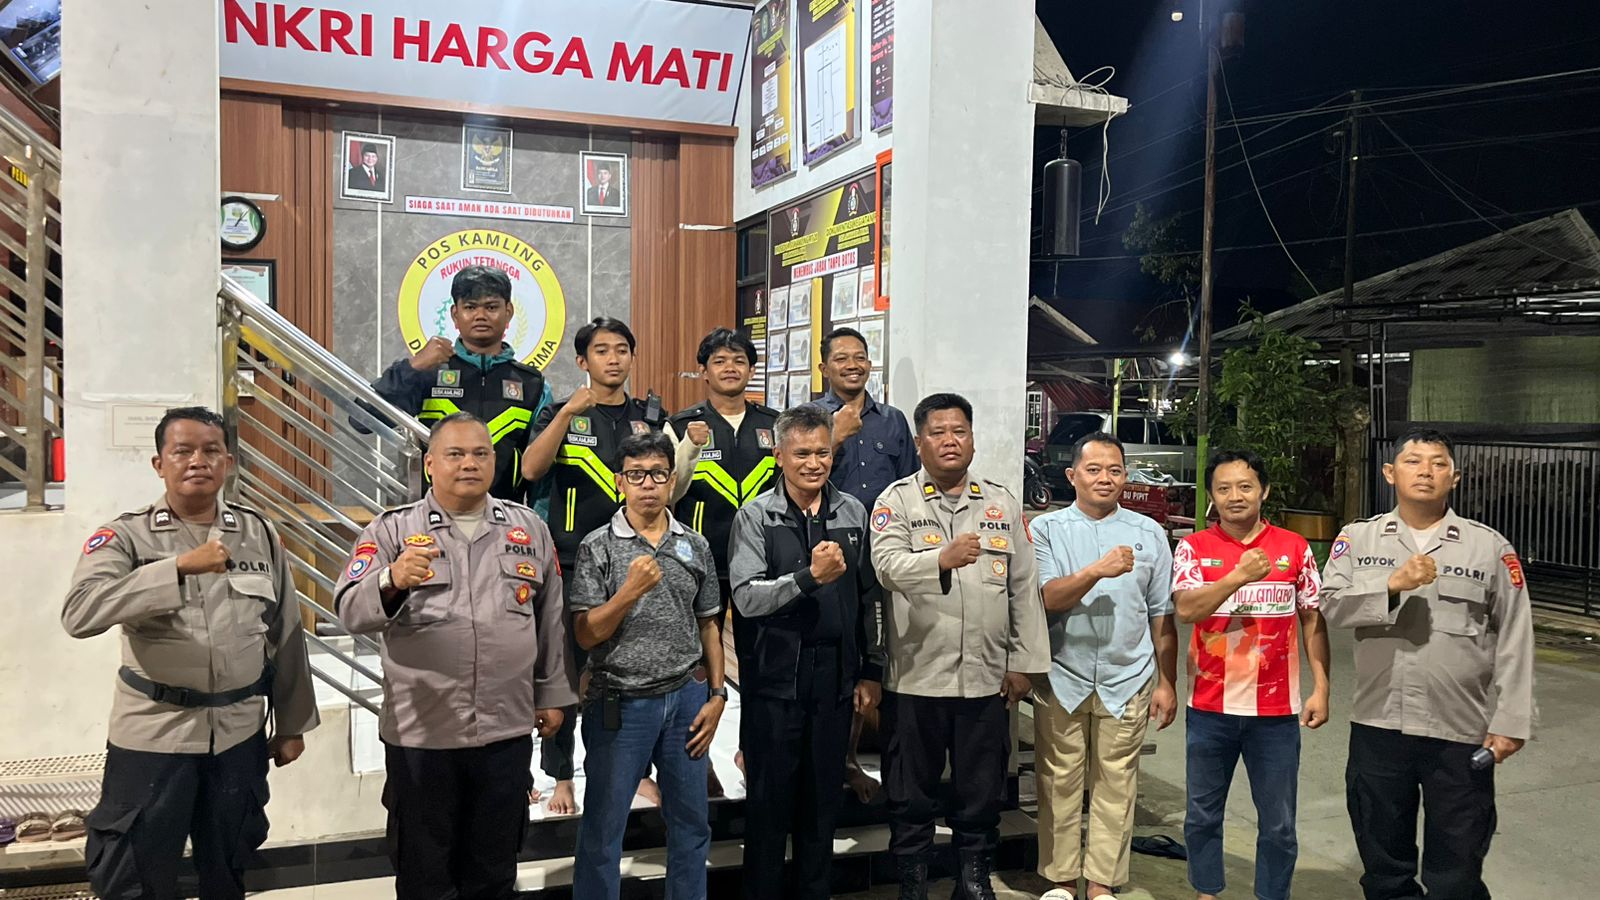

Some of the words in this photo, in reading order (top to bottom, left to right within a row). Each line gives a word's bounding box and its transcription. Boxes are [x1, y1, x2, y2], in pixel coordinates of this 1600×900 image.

[223, 0, 373, 57] NKRI
[393, 17, 594, 79] HARGA
[606, 41, 734, 92] MATI
[408, 199, 433, 209] SIAGA
[435, 201, 455, 210] SAAT
[458, 202, 482, 213] AMAN
[484, 204, 500, 214] ADA
[502, 206, 522, 215] SAAT
[524, 207, 572, 219] DIBUTUHKAN
[416, 239, 451, 270] POS
[458, 232, 545, 272] KAMLING
[440, 256, 472, 281] RUKUN
[473, 256, 521, 281] TETANGGA
[979, 521, 1010, 531] POLRI
[505, 544, 536, 557] POLRI
[1357, 556, 1396, 567] YOYOK
[1443, 565, 1486, 582] POLRI
